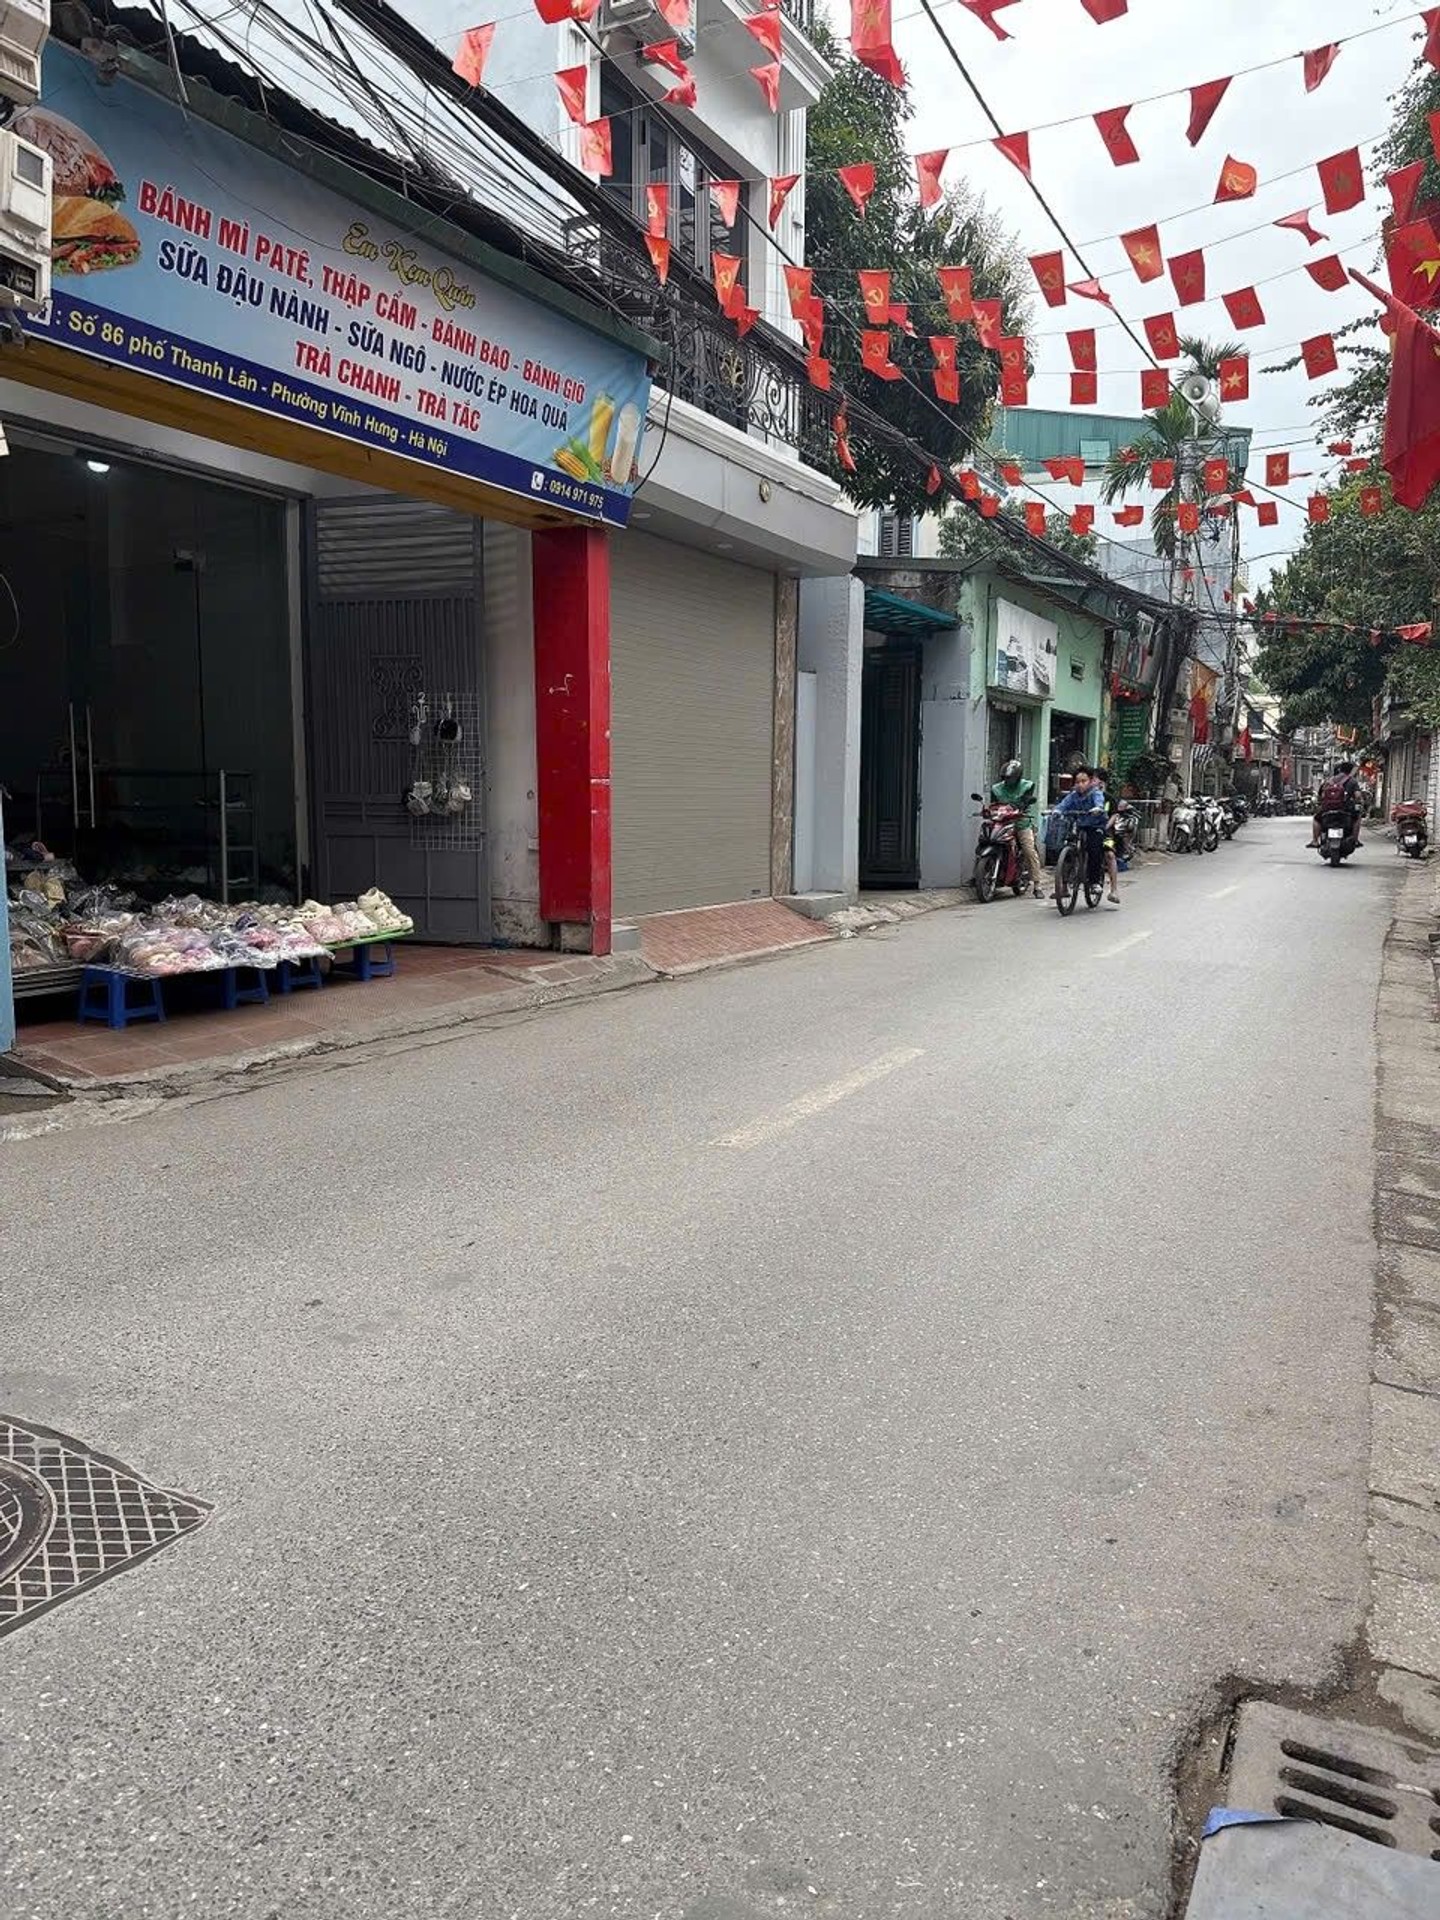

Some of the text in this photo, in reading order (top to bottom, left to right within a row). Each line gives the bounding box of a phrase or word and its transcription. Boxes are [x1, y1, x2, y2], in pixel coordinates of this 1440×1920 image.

[139, 181, 211, 239] BÁNH
[218, 217, 249, 256] MÌ
[255, 235, 313, 289] PATÊ,
[322, 266, 370, 309] THẬP
[376, 290, 417, 331] CẨM
[432, 318, 477, 357] BÁNH
[480, 340, 510, 372] BAO
[523, 359, 561, 394] BÁNH
[159, 239, 208, 286] SỮA
[216, 264, 264, 307] ĐẬU
[270, 286, 330, 334] NÀNH
[348, 320, 384, 358] SỮA
[390, 338, 426, 374] NGÔ
[441, 360, 484, 397] NƯỚC
[488, 376, 507, 405] ÉP
[510, 390, 537, 420] HOA
[541, 402, 569, 431] QUẢ
[432, 267, 476, 311] Quán
[68, 310, 99, 337] Số
[101, 322, 125, 346] 86
[128, 336, 168, 360] phố
[171, 345, 223, 381] Thanh
[228, 366, 258, 393] Lân
[271, 381, 328, 420] Phường
[332, 402, 361, 428] Vĩnh
[365, 414, 399, 443] Hưng
[408, 429, 425, 449] Hà
[427, 438, 448, 459] Nội
[296, 340, 331, 378] TRÀ
[337, 359, 401, 403] CHANH
[418, 389, 447, 421] TRÀ
[453, 399, 481, 432] TẮC
[549, 480, 571, 499] 0914
[572, 488, 588, 504] 971
[589, 493, 604, 509] 975
